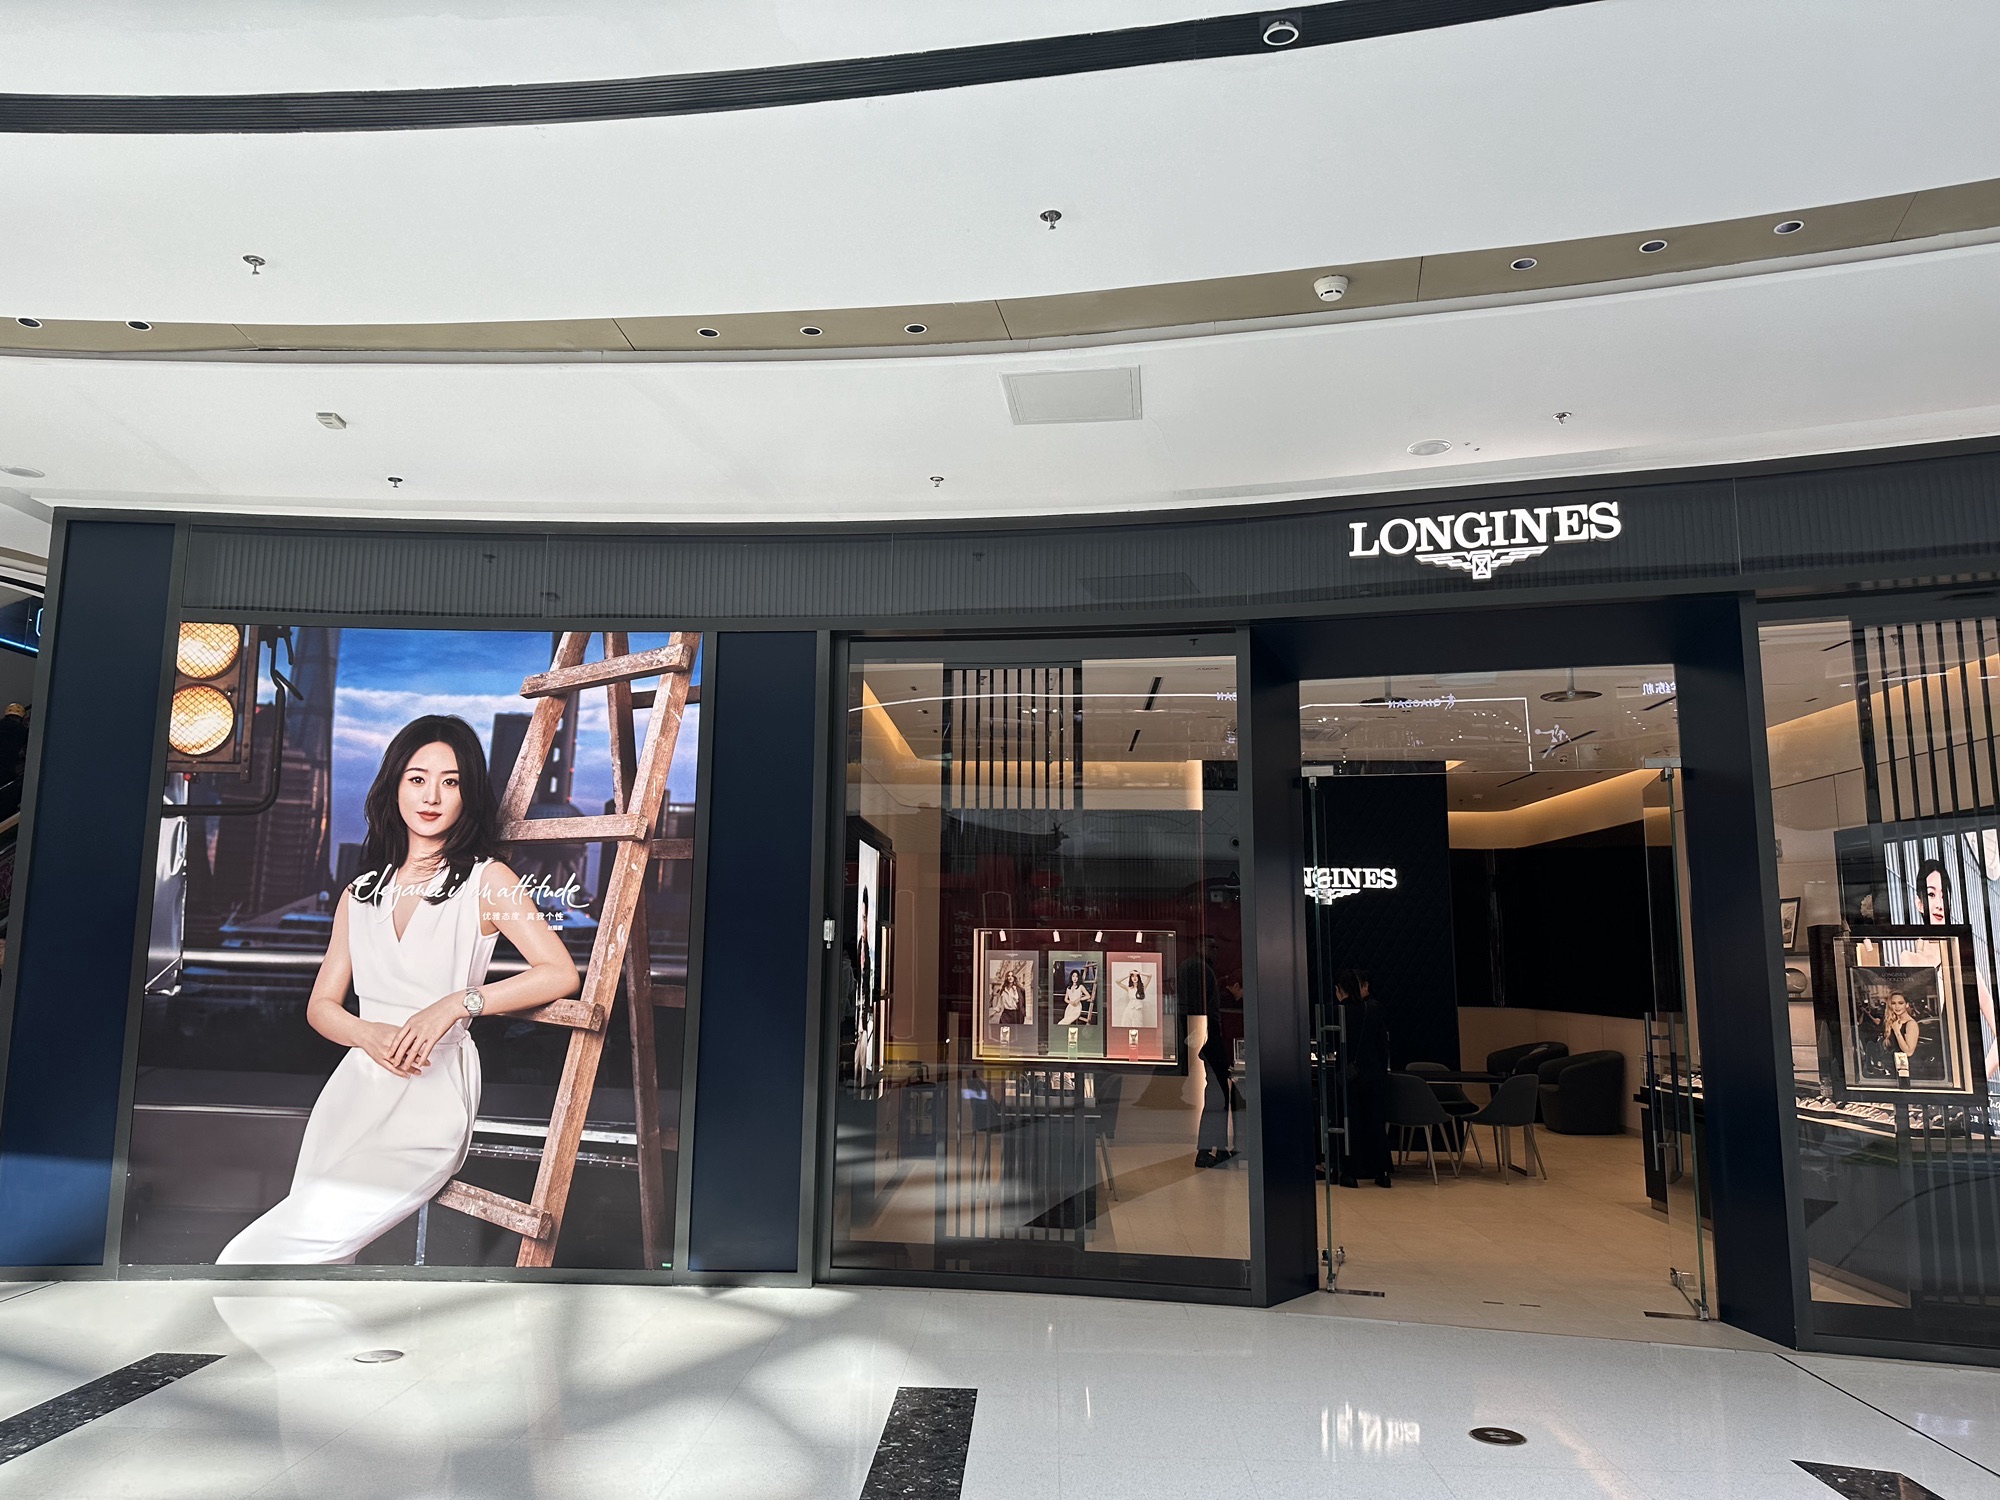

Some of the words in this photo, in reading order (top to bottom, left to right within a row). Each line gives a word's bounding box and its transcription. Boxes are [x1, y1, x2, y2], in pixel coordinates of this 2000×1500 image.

[1348, 501, 1622, 557] LONGINES
[497, 872, 590, 909] attitude
[482, 911, 520, 922] 优雅态度
[526, 911, 564, 922] 真我个性
